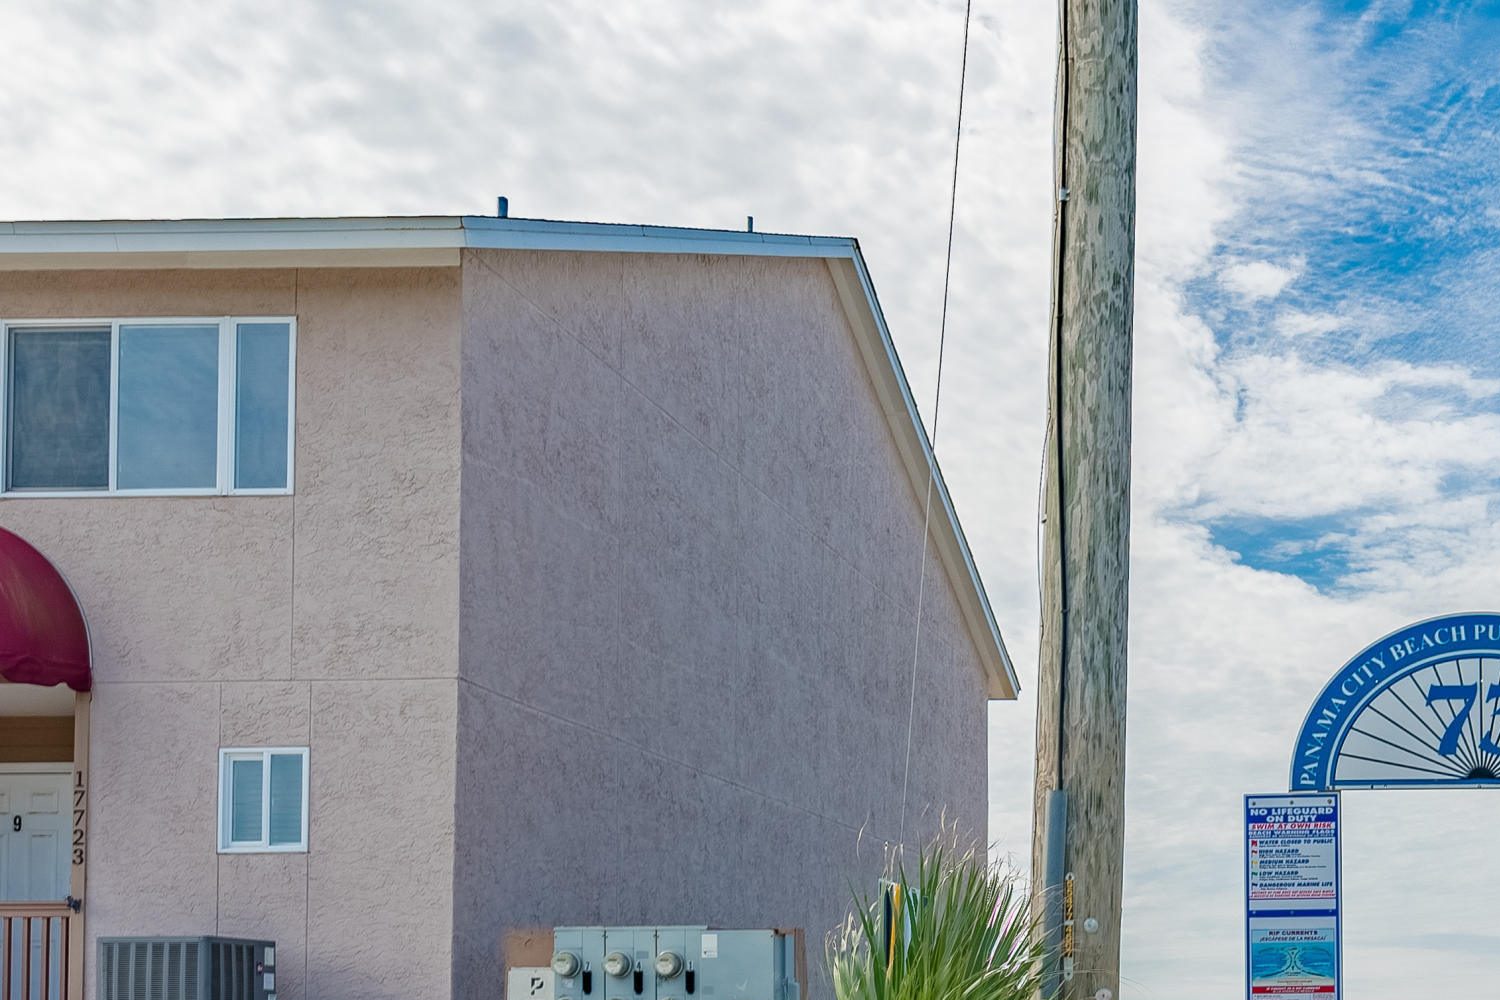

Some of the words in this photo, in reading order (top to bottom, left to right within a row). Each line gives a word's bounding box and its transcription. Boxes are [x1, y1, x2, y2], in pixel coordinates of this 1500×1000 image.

[1300, 698, 1348, 785] PANAMA
[1341, 652, 1386, 696] CITY
[1390, 626, 1466, 662] BEACH
[14, 815, 22, 832] 9
[72, 771, 86, 865] 17723
